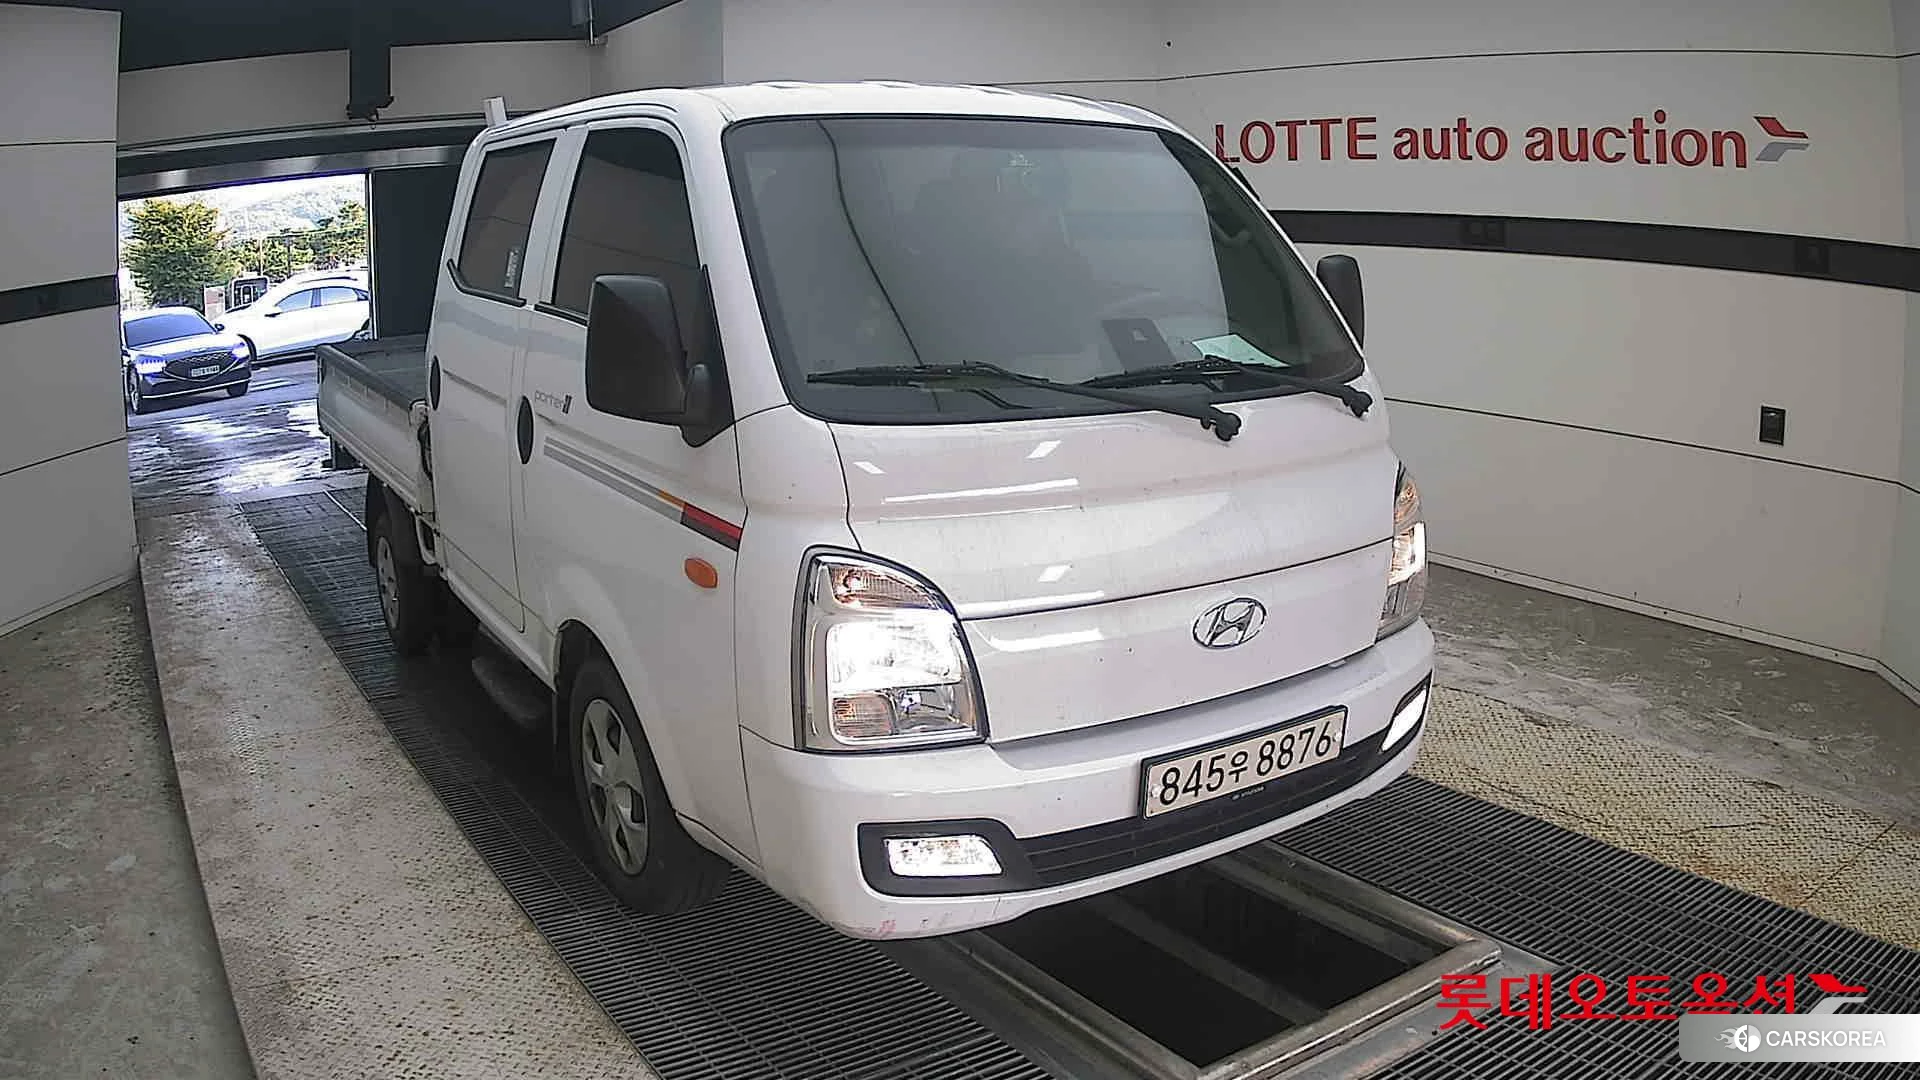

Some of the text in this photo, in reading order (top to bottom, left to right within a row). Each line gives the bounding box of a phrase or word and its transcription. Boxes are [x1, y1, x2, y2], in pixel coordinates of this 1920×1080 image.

[1216, 110, 1747, 168] LOTTE auto auction
